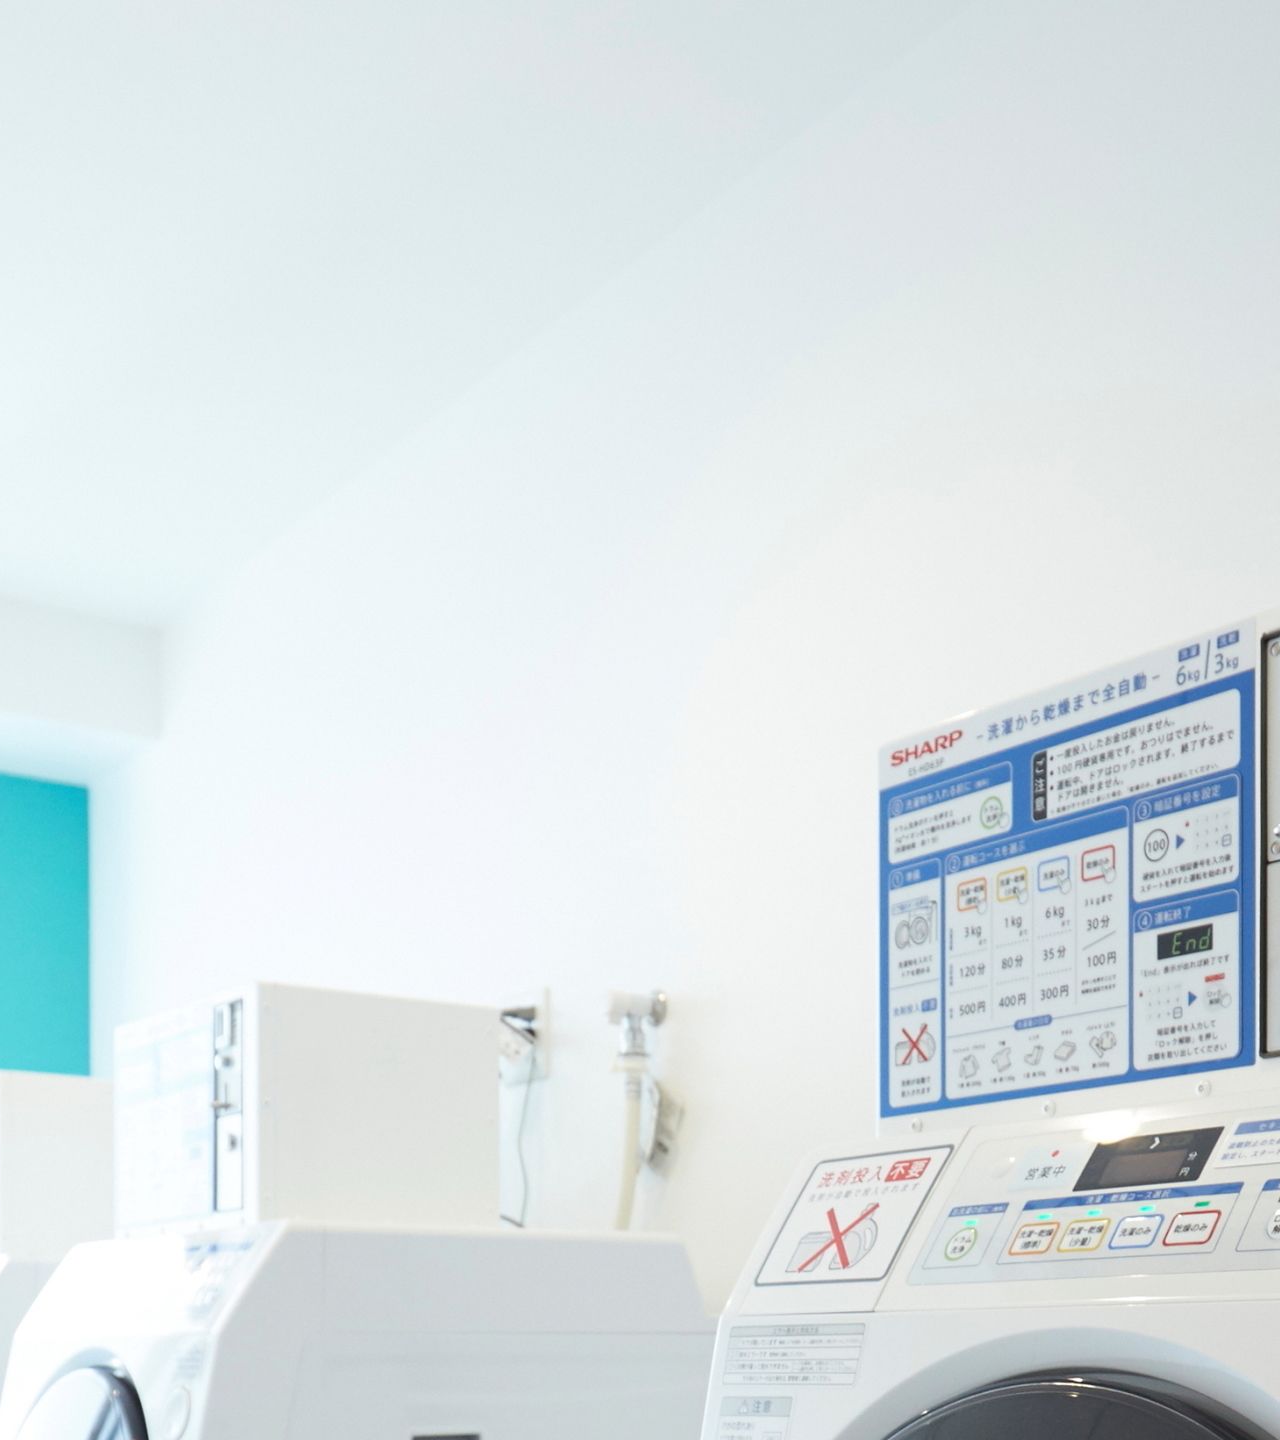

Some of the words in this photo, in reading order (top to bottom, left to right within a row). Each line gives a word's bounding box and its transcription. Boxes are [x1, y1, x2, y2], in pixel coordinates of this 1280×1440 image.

[1215, 653, 1239, 674] 3kg
[1176, 665, 1200, 686] 6kg
[891, 729, 963, 767] SHARP
[1147, 838, 1166, 854] 100
[1045, 906, 1065, 919] 6kg
[1004, 915, 1022, 928] 1kg
[1087, 914, 1110, 931] 30分
[964, 925, 982, 938] 3kg
[1172, 926, 1211, 956] End
[1043, 945, 1066, 961] 35分
[1087, 951, 1117, 968] 100円
[959, 963, 986, 978] 120分
[1001, 955, 1023, 970] 80分
[998, 993, 1027, 1008] 400円
[1040, 984, 1069, 1001] 300円
[959, 1001, 986, 1016] 500円
[817, 1165, 883, 1189] 洗剤投入
[890, 1158, 927, 1181] 不要
[1024, 1164, 1066, 1182] 営業中
[1173, 1223, 1209, 1234] 乾燥のみ
